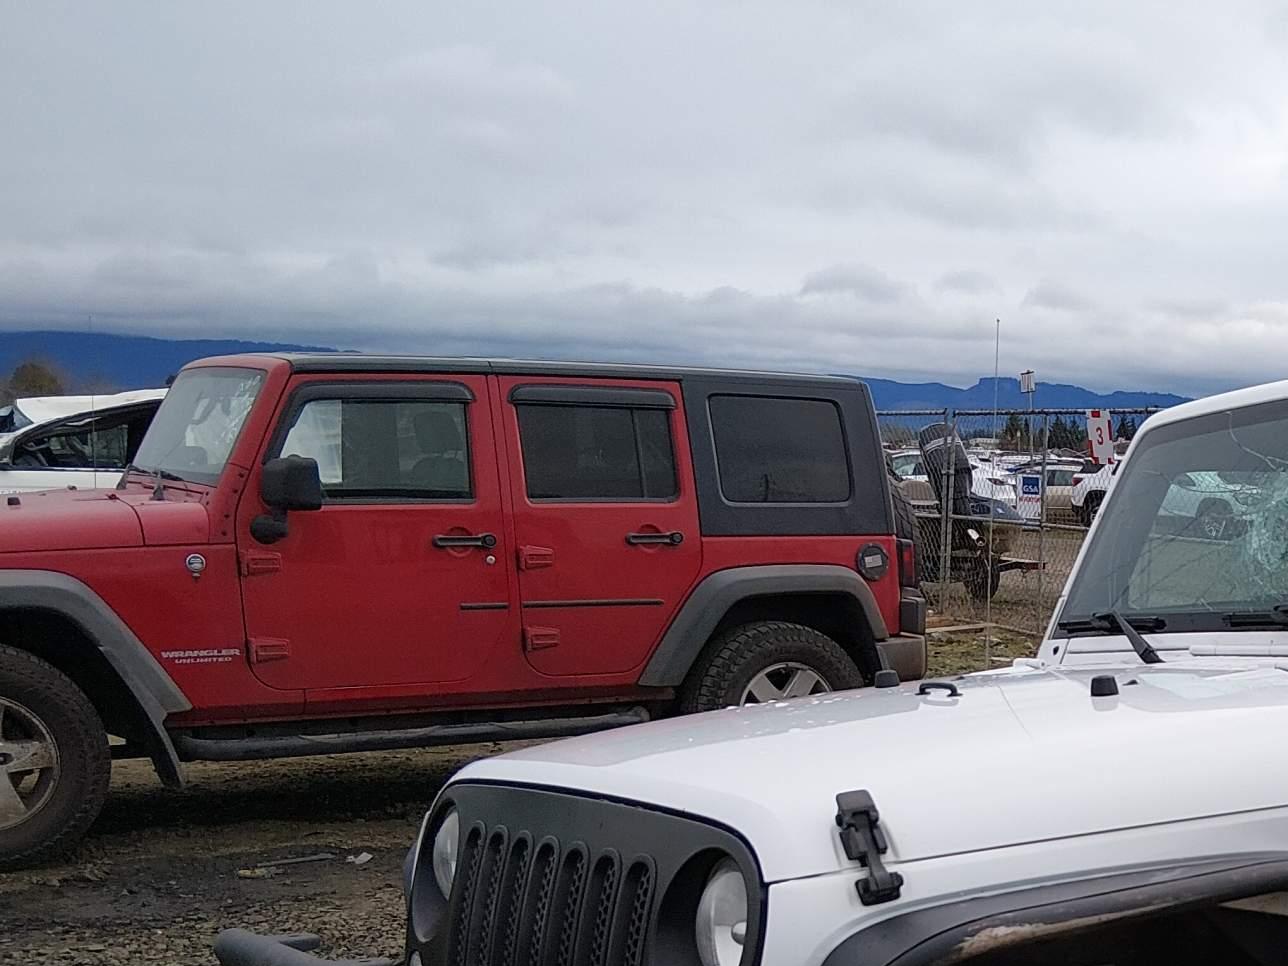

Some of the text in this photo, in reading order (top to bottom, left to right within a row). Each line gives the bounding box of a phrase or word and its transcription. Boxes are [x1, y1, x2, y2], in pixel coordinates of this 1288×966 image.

[1095, 427, 1104, 445] 3
[1022, 485, 1039, 493] GSA
[161, 648, 241, 658] WRANGLER
[175, 656, 232, 664] UNLIMITED
